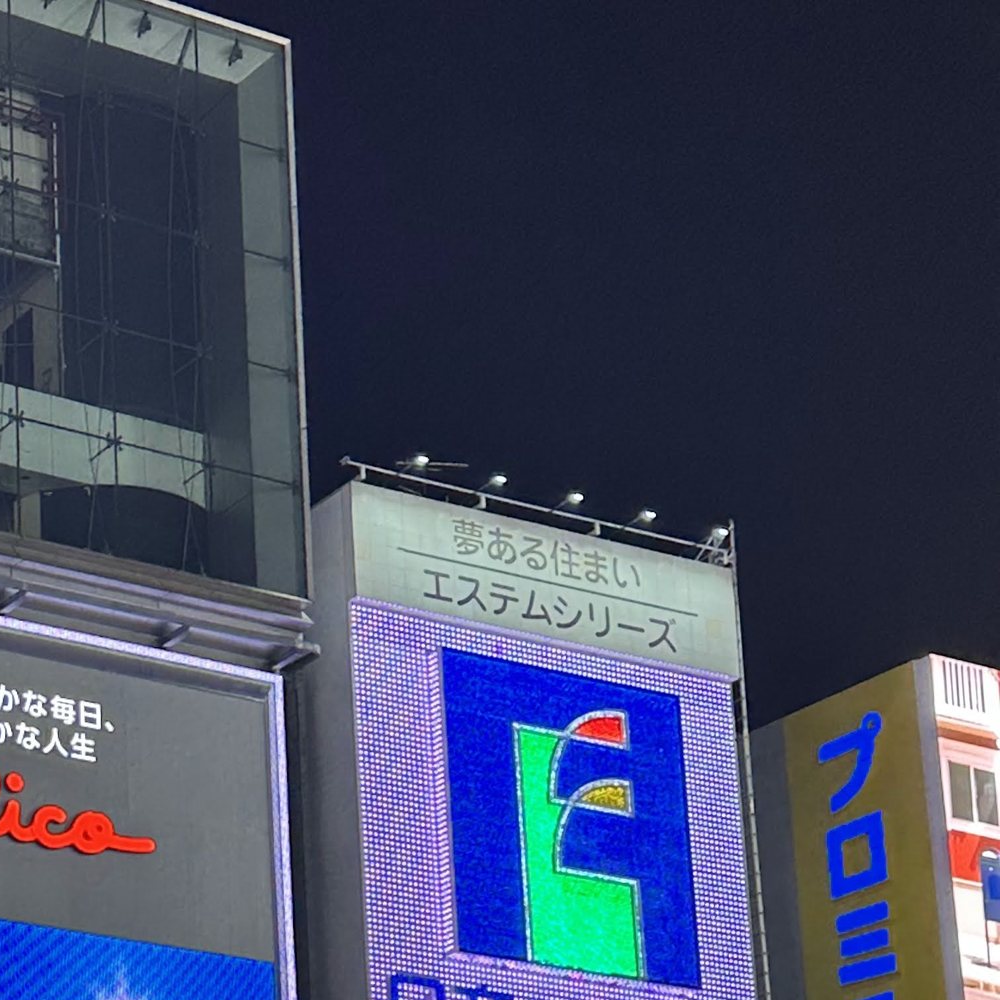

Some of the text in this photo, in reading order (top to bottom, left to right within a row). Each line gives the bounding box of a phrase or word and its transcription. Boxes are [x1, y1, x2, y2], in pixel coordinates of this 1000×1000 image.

[452, 518, 641, 589] 夢ある住まい
[422, 569, 677, 653] エステムシリーズ
